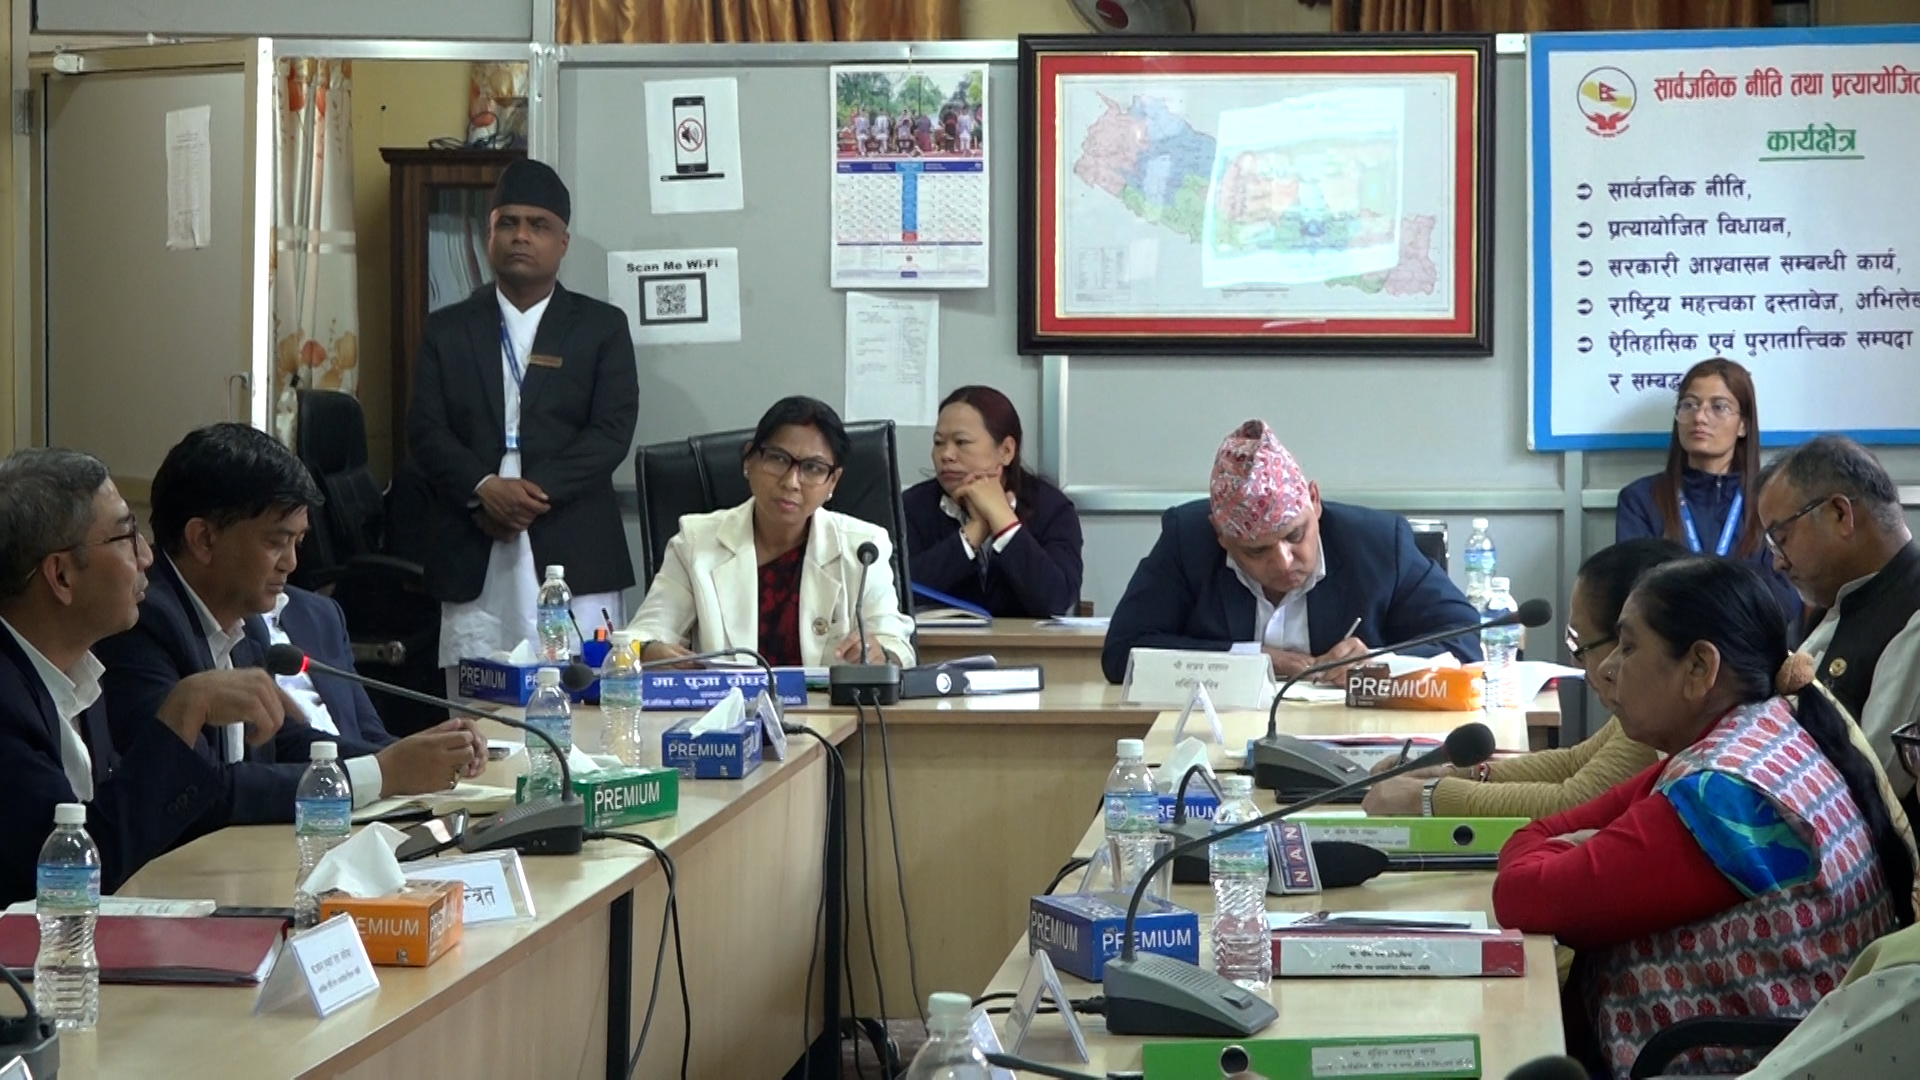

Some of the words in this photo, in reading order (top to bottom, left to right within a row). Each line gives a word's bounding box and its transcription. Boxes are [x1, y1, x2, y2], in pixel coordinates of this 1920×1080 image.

[1653, 69, 1737, 101] सार्वजनिक
[1745, 67, 1783, 98] नीति
[1790, 72, 1823, 97] तथा
[1766, 122, 1857, 153] कार्यक्षेत्र
[1607, 174, 1697, 201] सार्वजनिक
[1705, 173, 1752, 201] नीति,
[1607, 214, 1706, 239] प्रत्यायोजित
[1718, 211, 1792, 238] विधायन,
[626, 262, 660, 273] Scan
[663, 261, 683, 270] Me
[686, 258, 719, 270] Wi-Fi
[1607, 252, 1679, 280] सरकारी
[1689, 255, 1770, 276] आश्वासन
[1780, 249, 1847, 274] सम्बन्धी
[1857, 247, 1901, 274] कार्य,
[1765, 289, 1844, 315] दस्तावेज,
[1608, 328, 1698, 356] ऐतिहासिक
[1708, 328, 1736, 356] एवं
[1856, 331, 1914, 350] सम्पदा
[1608, 373, 1623, 394] र
[461, 665, 506, 690] PREMIUM
[1349, 677, 1448, 698] PREMIUM
[668, 743, 736, 757] PREMIUM
[594, 781, 660, 812] PREMIUM
[1158, 804, 1220, 819] REMIUM
[356, 917, 420, 936] EMIUM
[1031, 911, 1078, 952] PREMIUM
